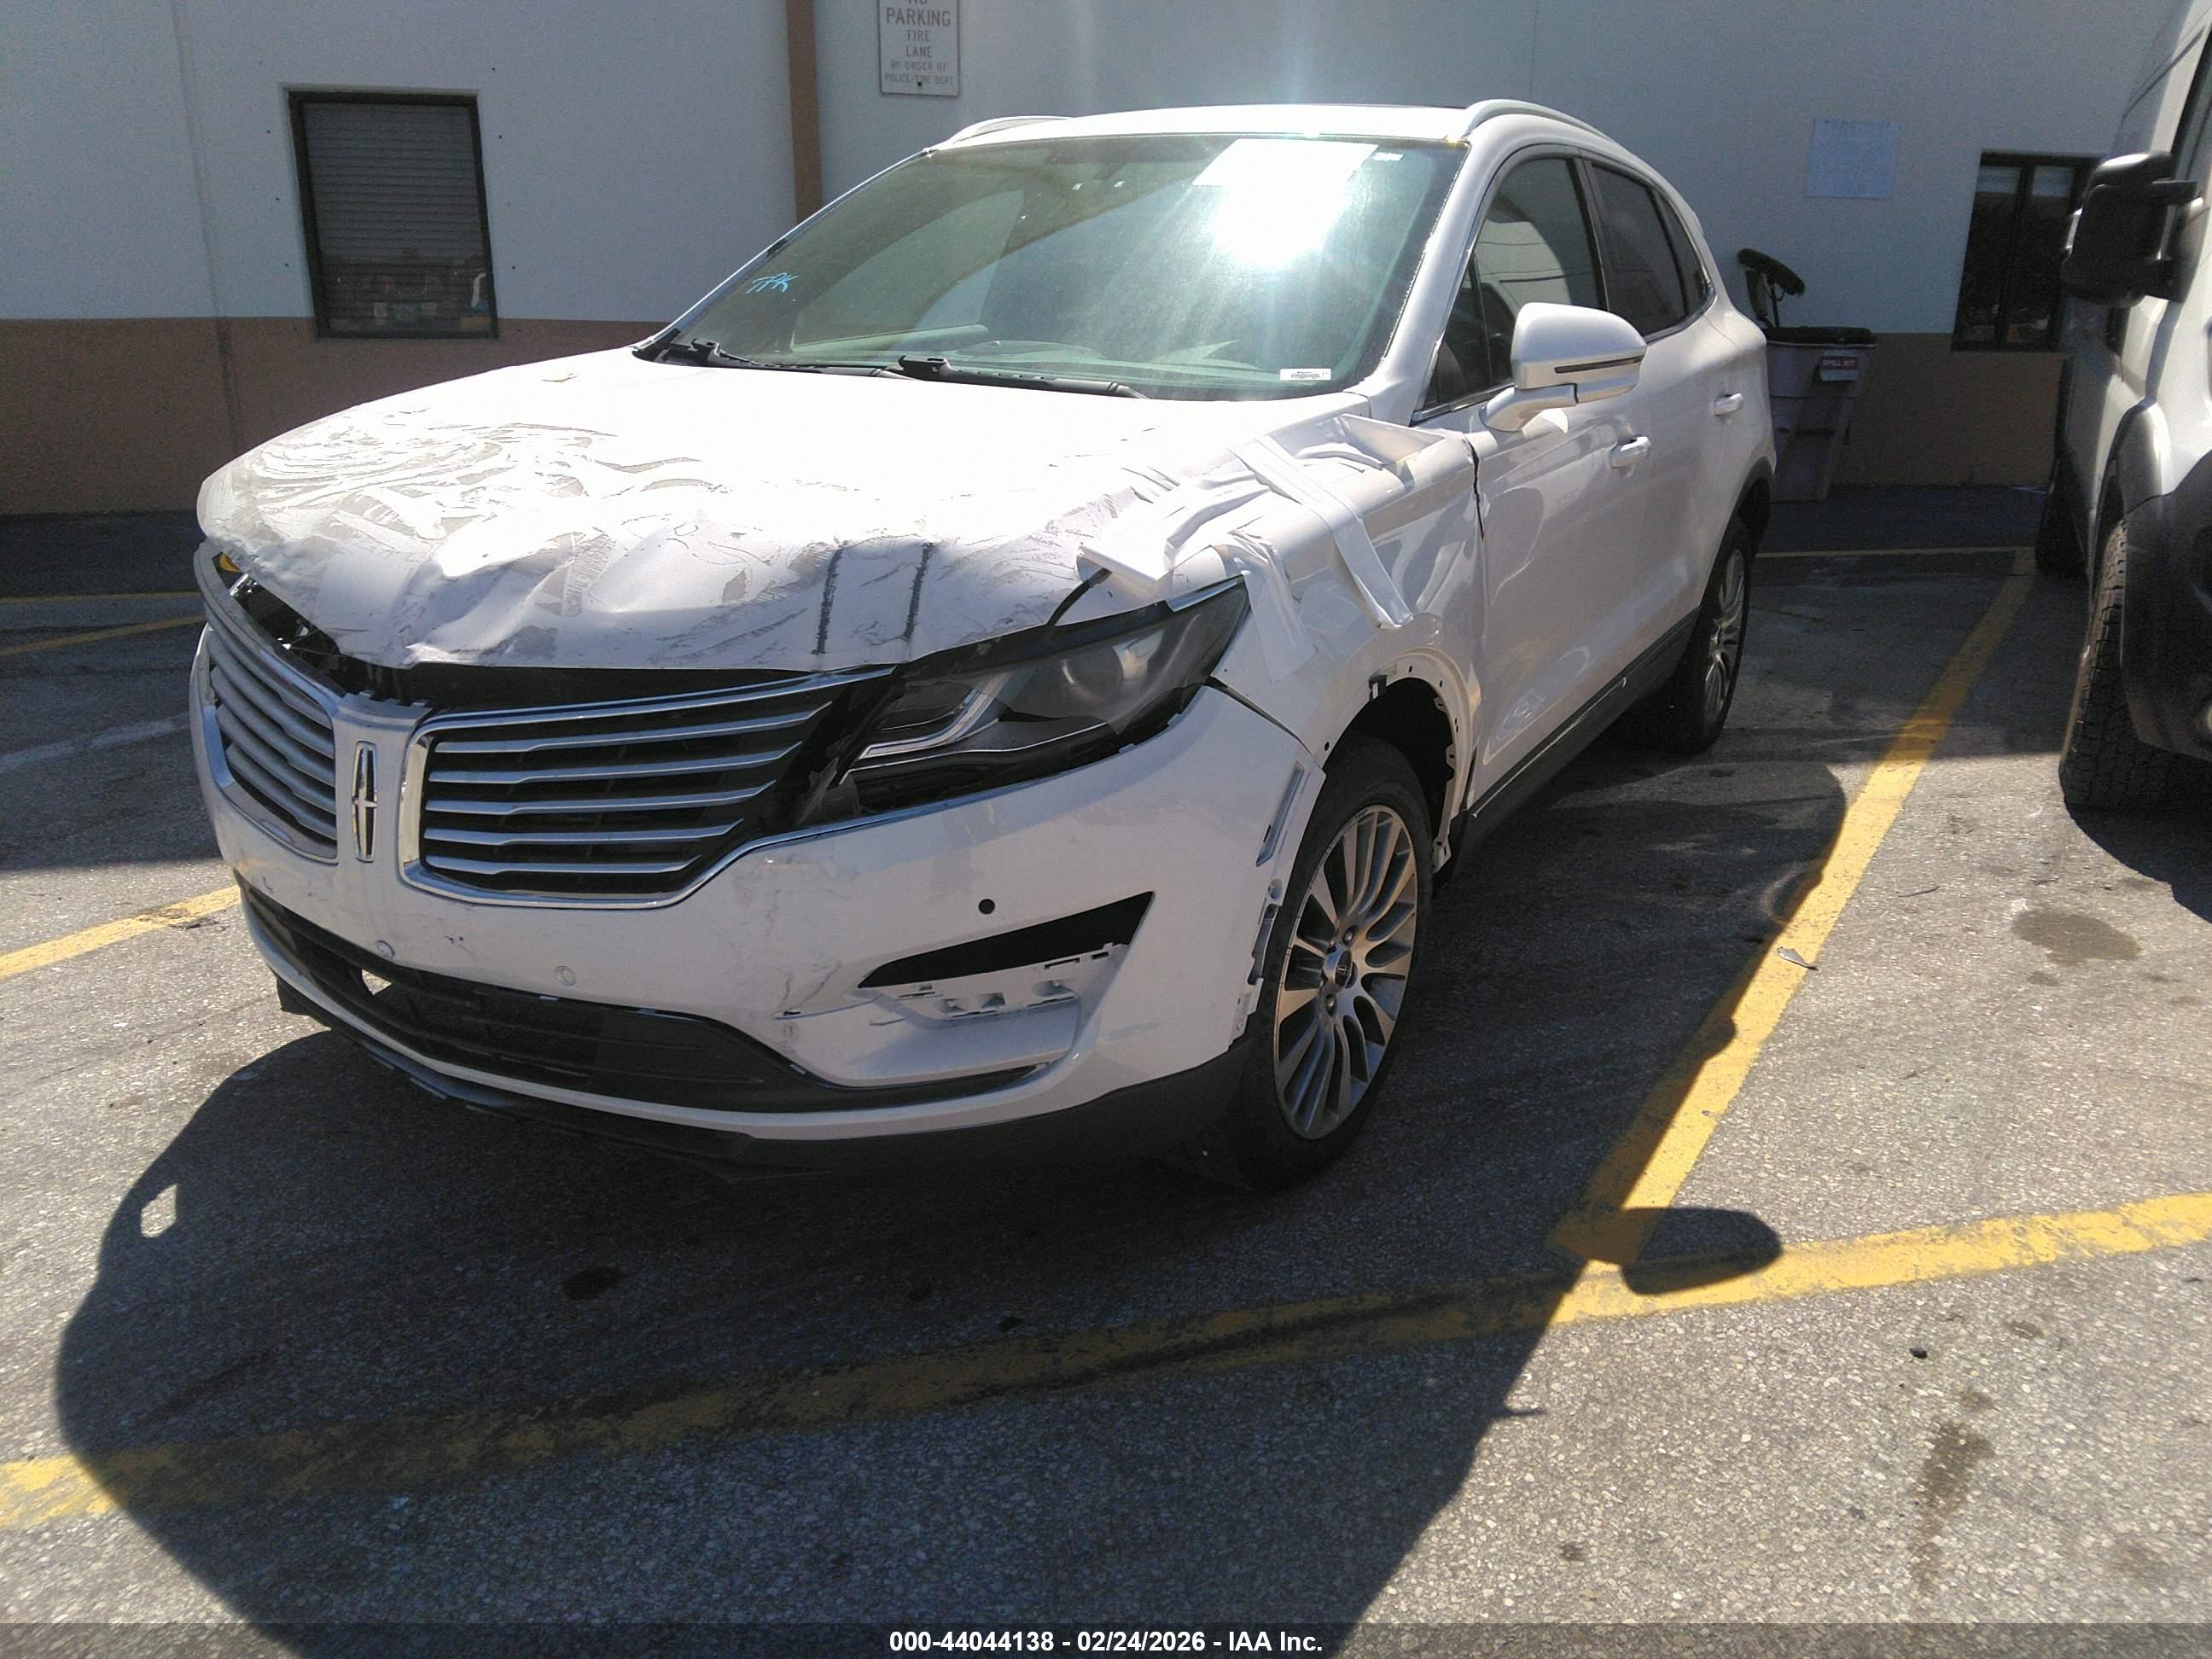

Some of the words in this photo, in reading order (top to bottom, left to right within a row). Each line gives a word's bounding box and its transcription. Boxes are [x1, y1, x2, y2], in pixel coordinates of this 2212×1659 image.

[886, 7, 952, 27] PARKING
[906, 29, 931, 42] FIRE
[905, 45, 933, 58] LANE
